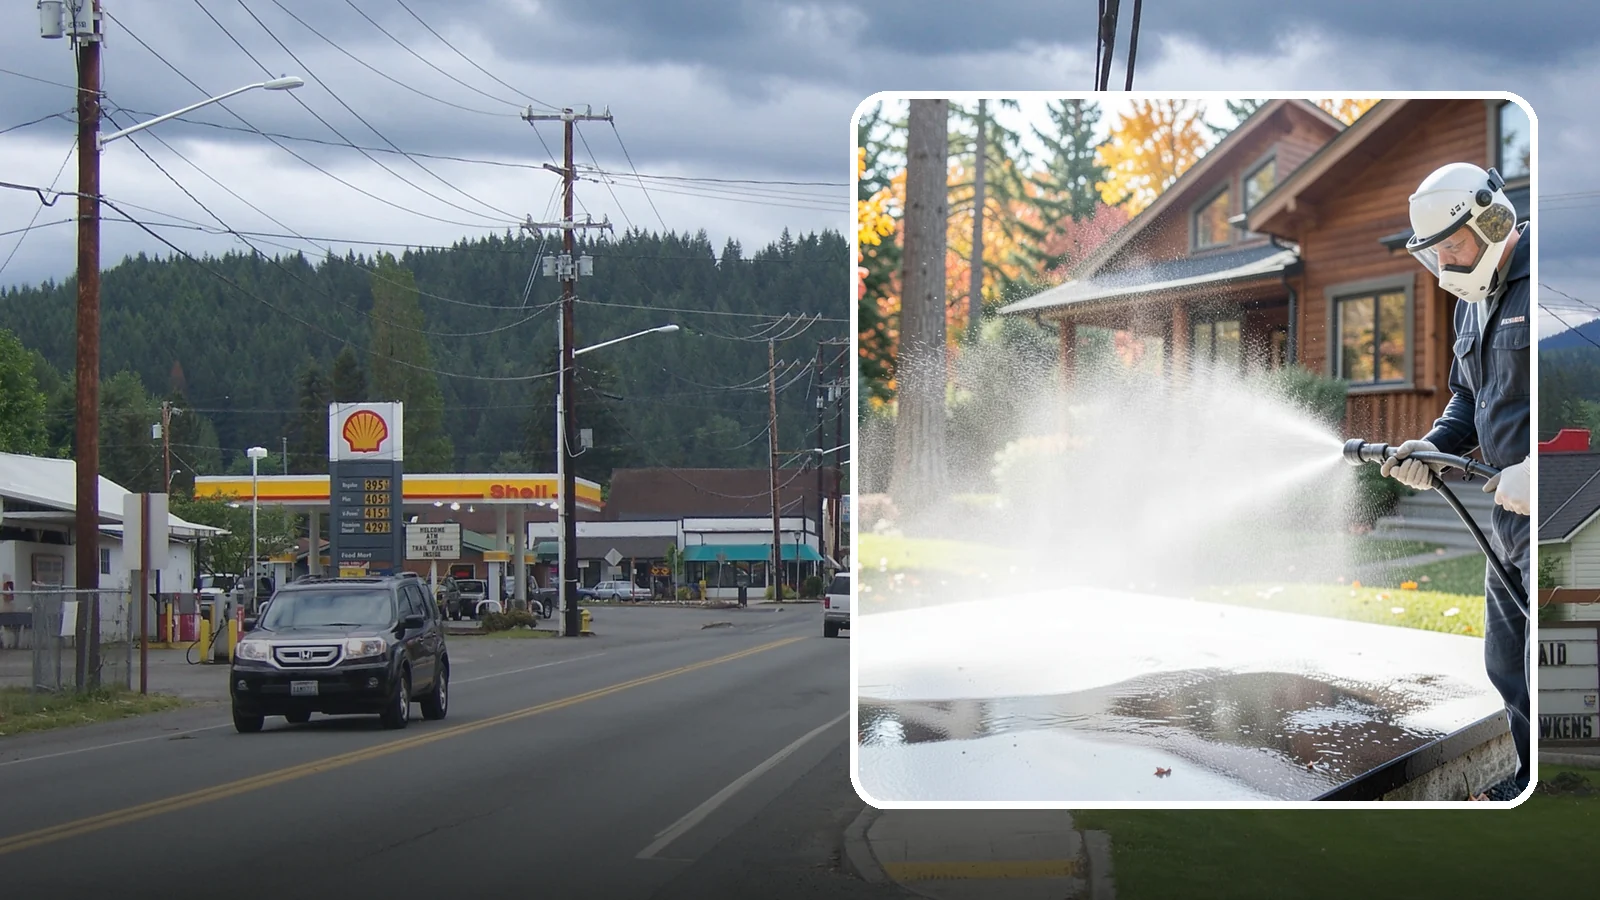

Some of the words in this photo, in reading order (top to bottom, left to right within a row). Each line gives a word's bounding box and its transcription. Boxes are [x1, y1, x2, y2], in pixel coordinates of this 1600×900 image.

[366, 479, 383, 490] 395
[490, 484, 547, 499] Shell
[366, 494, 383, 504] 405
[366, 508, 383, 518] 415
[366, 522, 383, 533] 429
